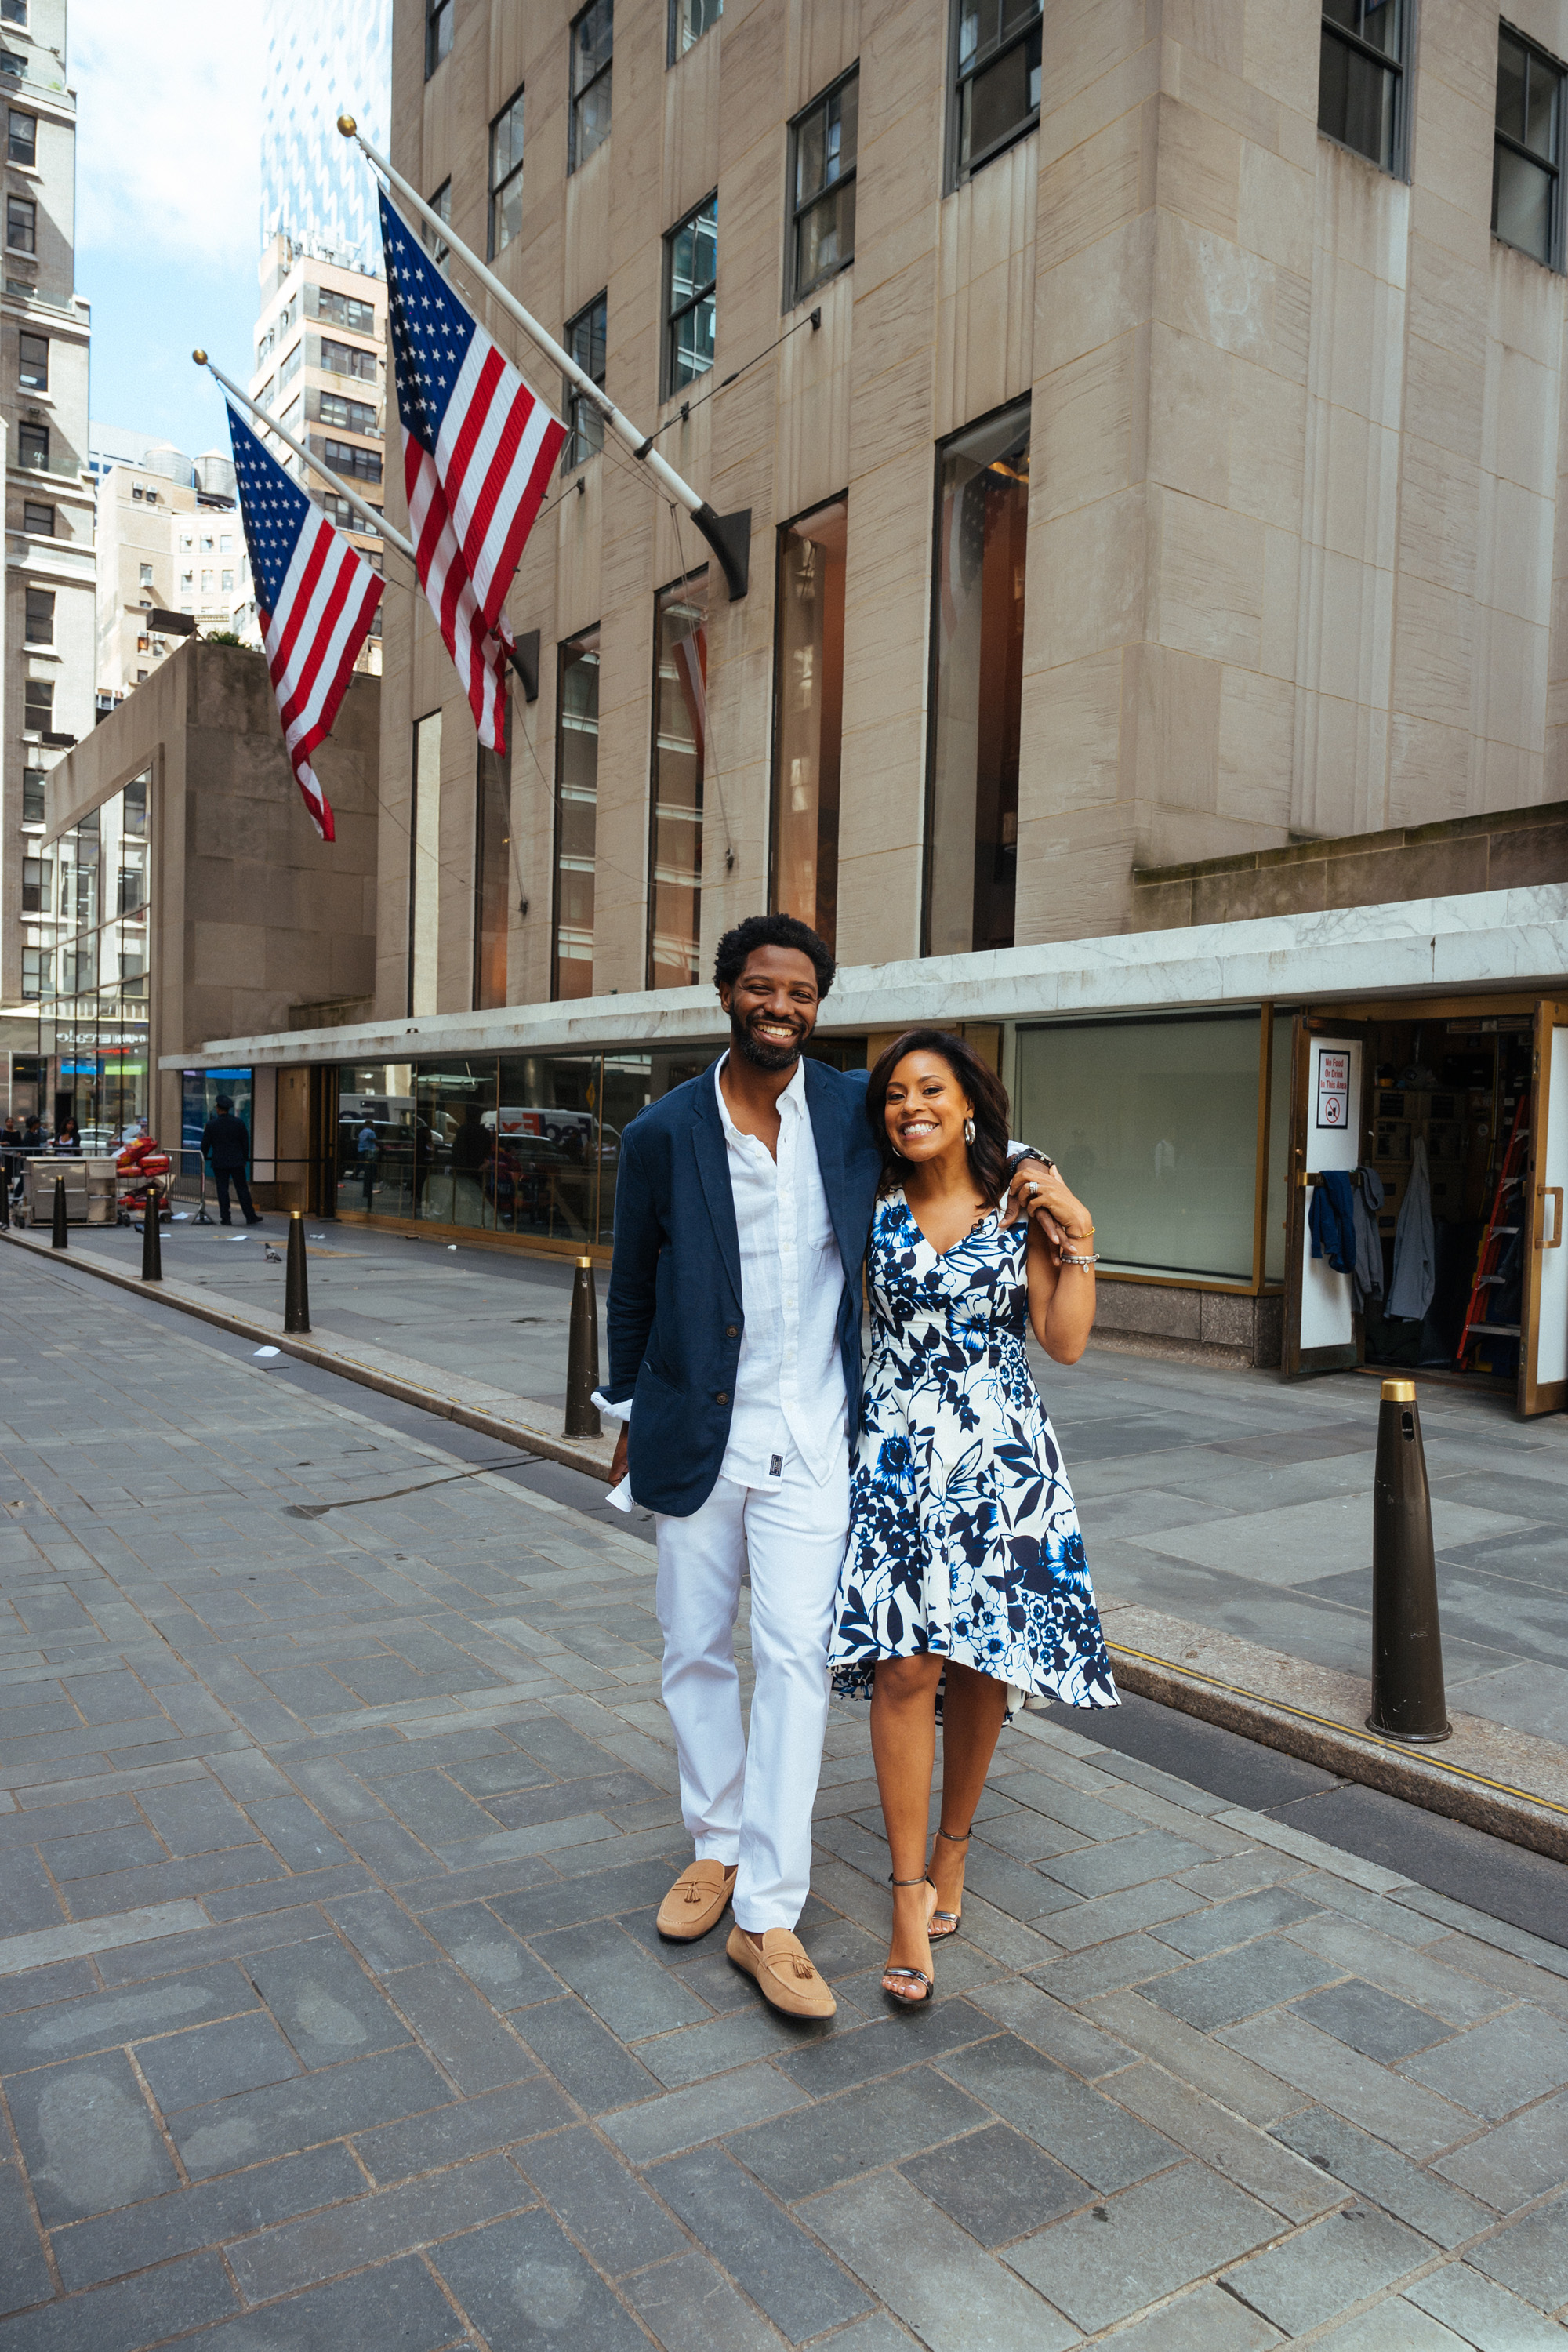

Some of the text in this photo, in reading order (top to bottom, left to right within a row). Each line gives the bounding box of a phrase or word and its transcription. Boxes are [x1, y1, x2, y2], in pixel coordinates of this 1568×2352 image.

[1325, 1058, 1344, 1067] No Food
[1325, 1069, 1343, 1078] Or Drink
[1320, 1080, 1347, 1090] In This Area
